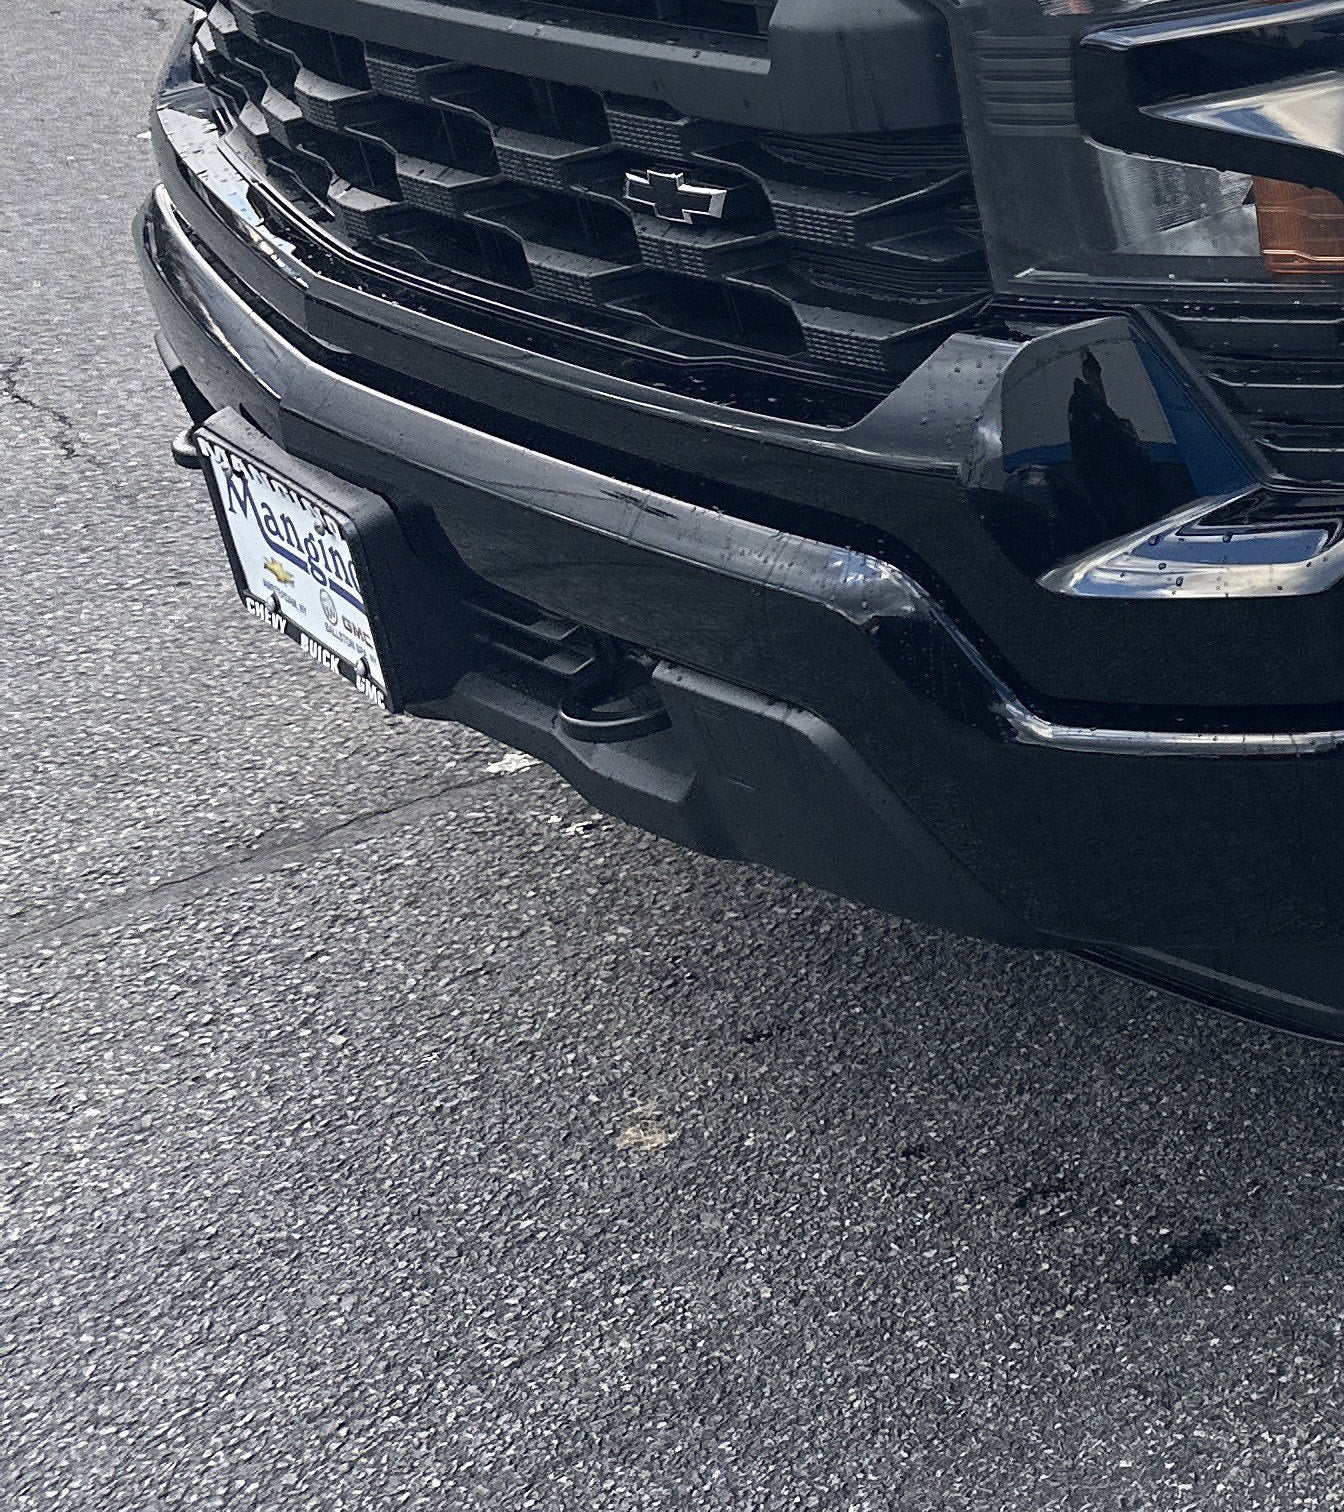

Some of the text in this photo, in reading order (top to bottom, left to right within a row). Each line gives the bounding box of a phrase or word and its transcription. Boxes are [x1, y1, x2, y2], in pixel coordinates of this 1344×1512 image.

[246, 596, 287, 635] CHEVY
[300, 633, 340, 676] BUICK
[355, 675, 386, 710] GMC
